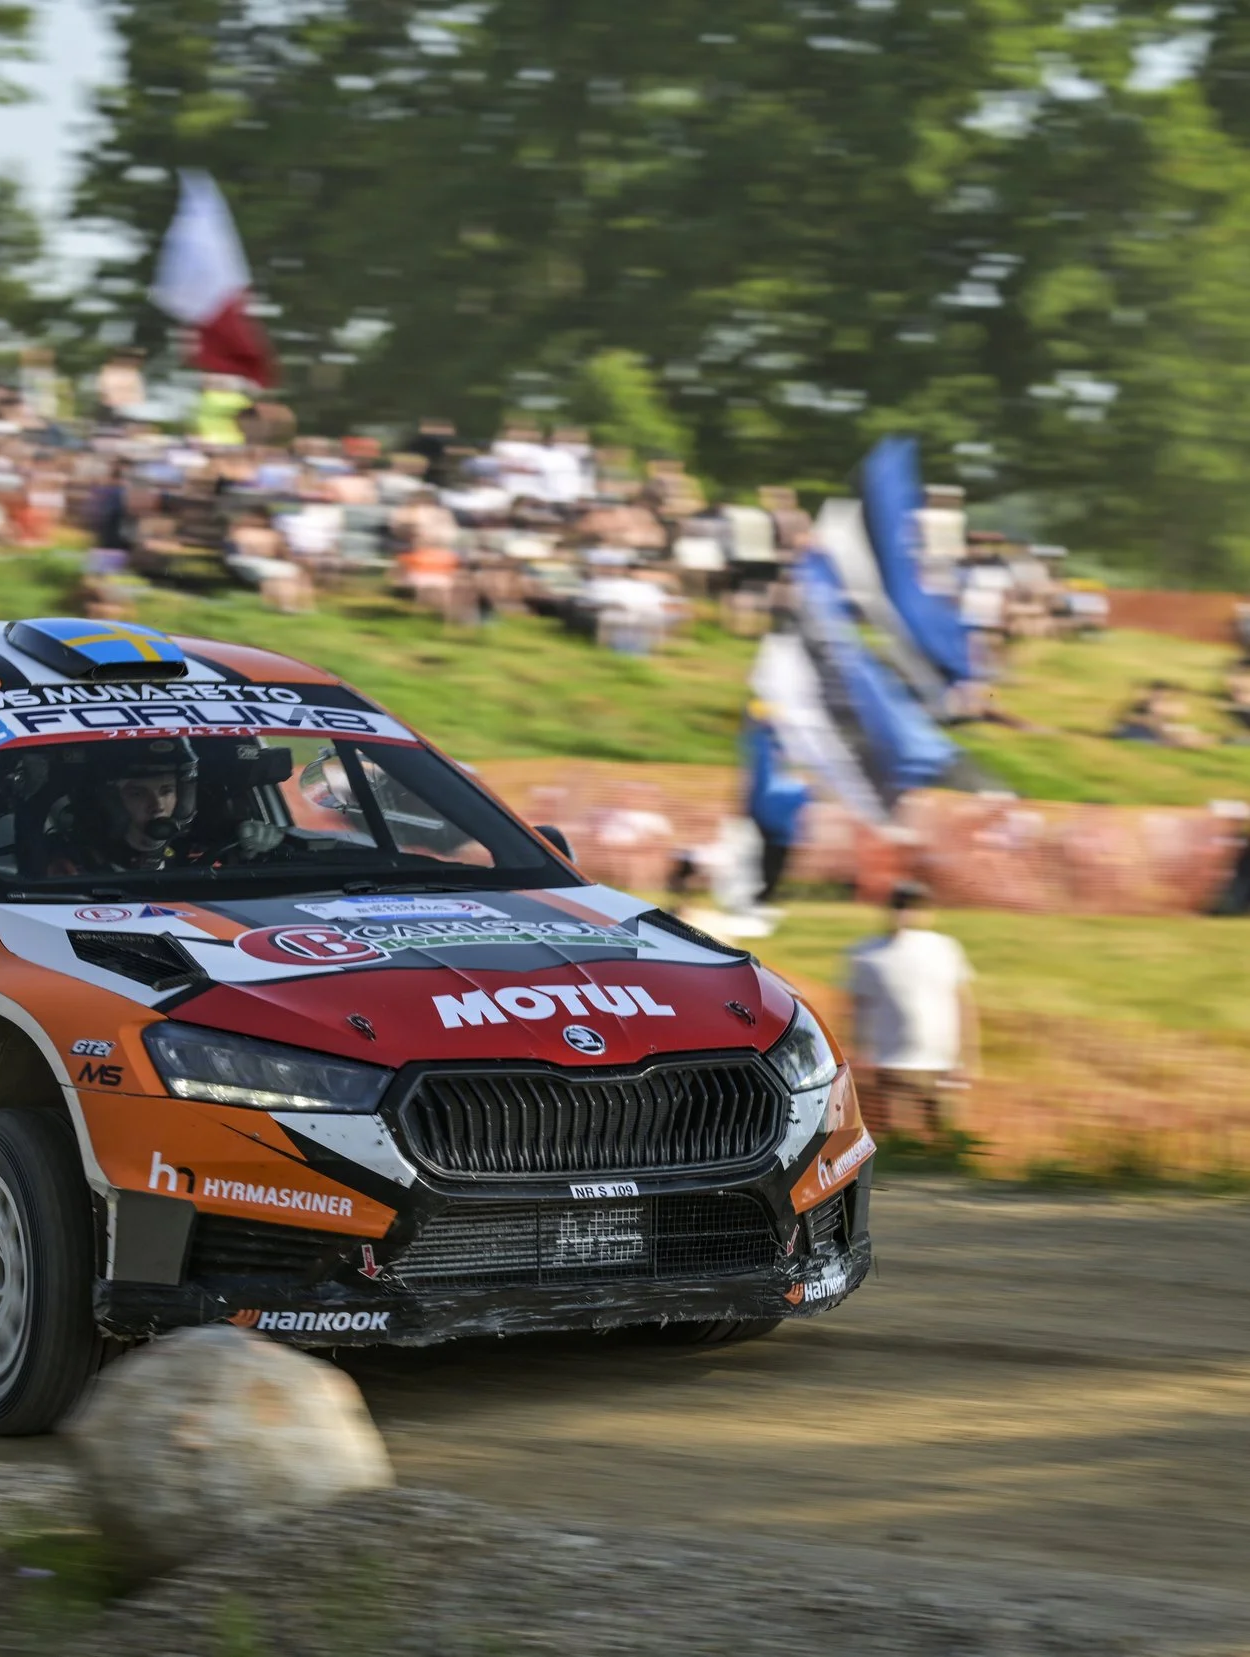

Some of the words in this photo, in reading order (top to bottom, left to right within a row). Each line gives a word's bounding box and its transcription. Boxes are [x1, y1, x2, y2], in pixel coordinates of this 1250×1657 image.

[43, 683, 303, 704] MUNARETTO
[12, 705, 379, 733] FORUM8
[350, 920, 638, 941] CARLSSON
[431, 984, 676, 1029] MOTUL
[78, 1062, 124, 1086] MS
[203, 1177, 353, 1217] HYRMASKINER
[575, 1187, 595, 1198] NR
[598, 1186, 608, 1197] S
[611, 1185, 634, 1197] 109
